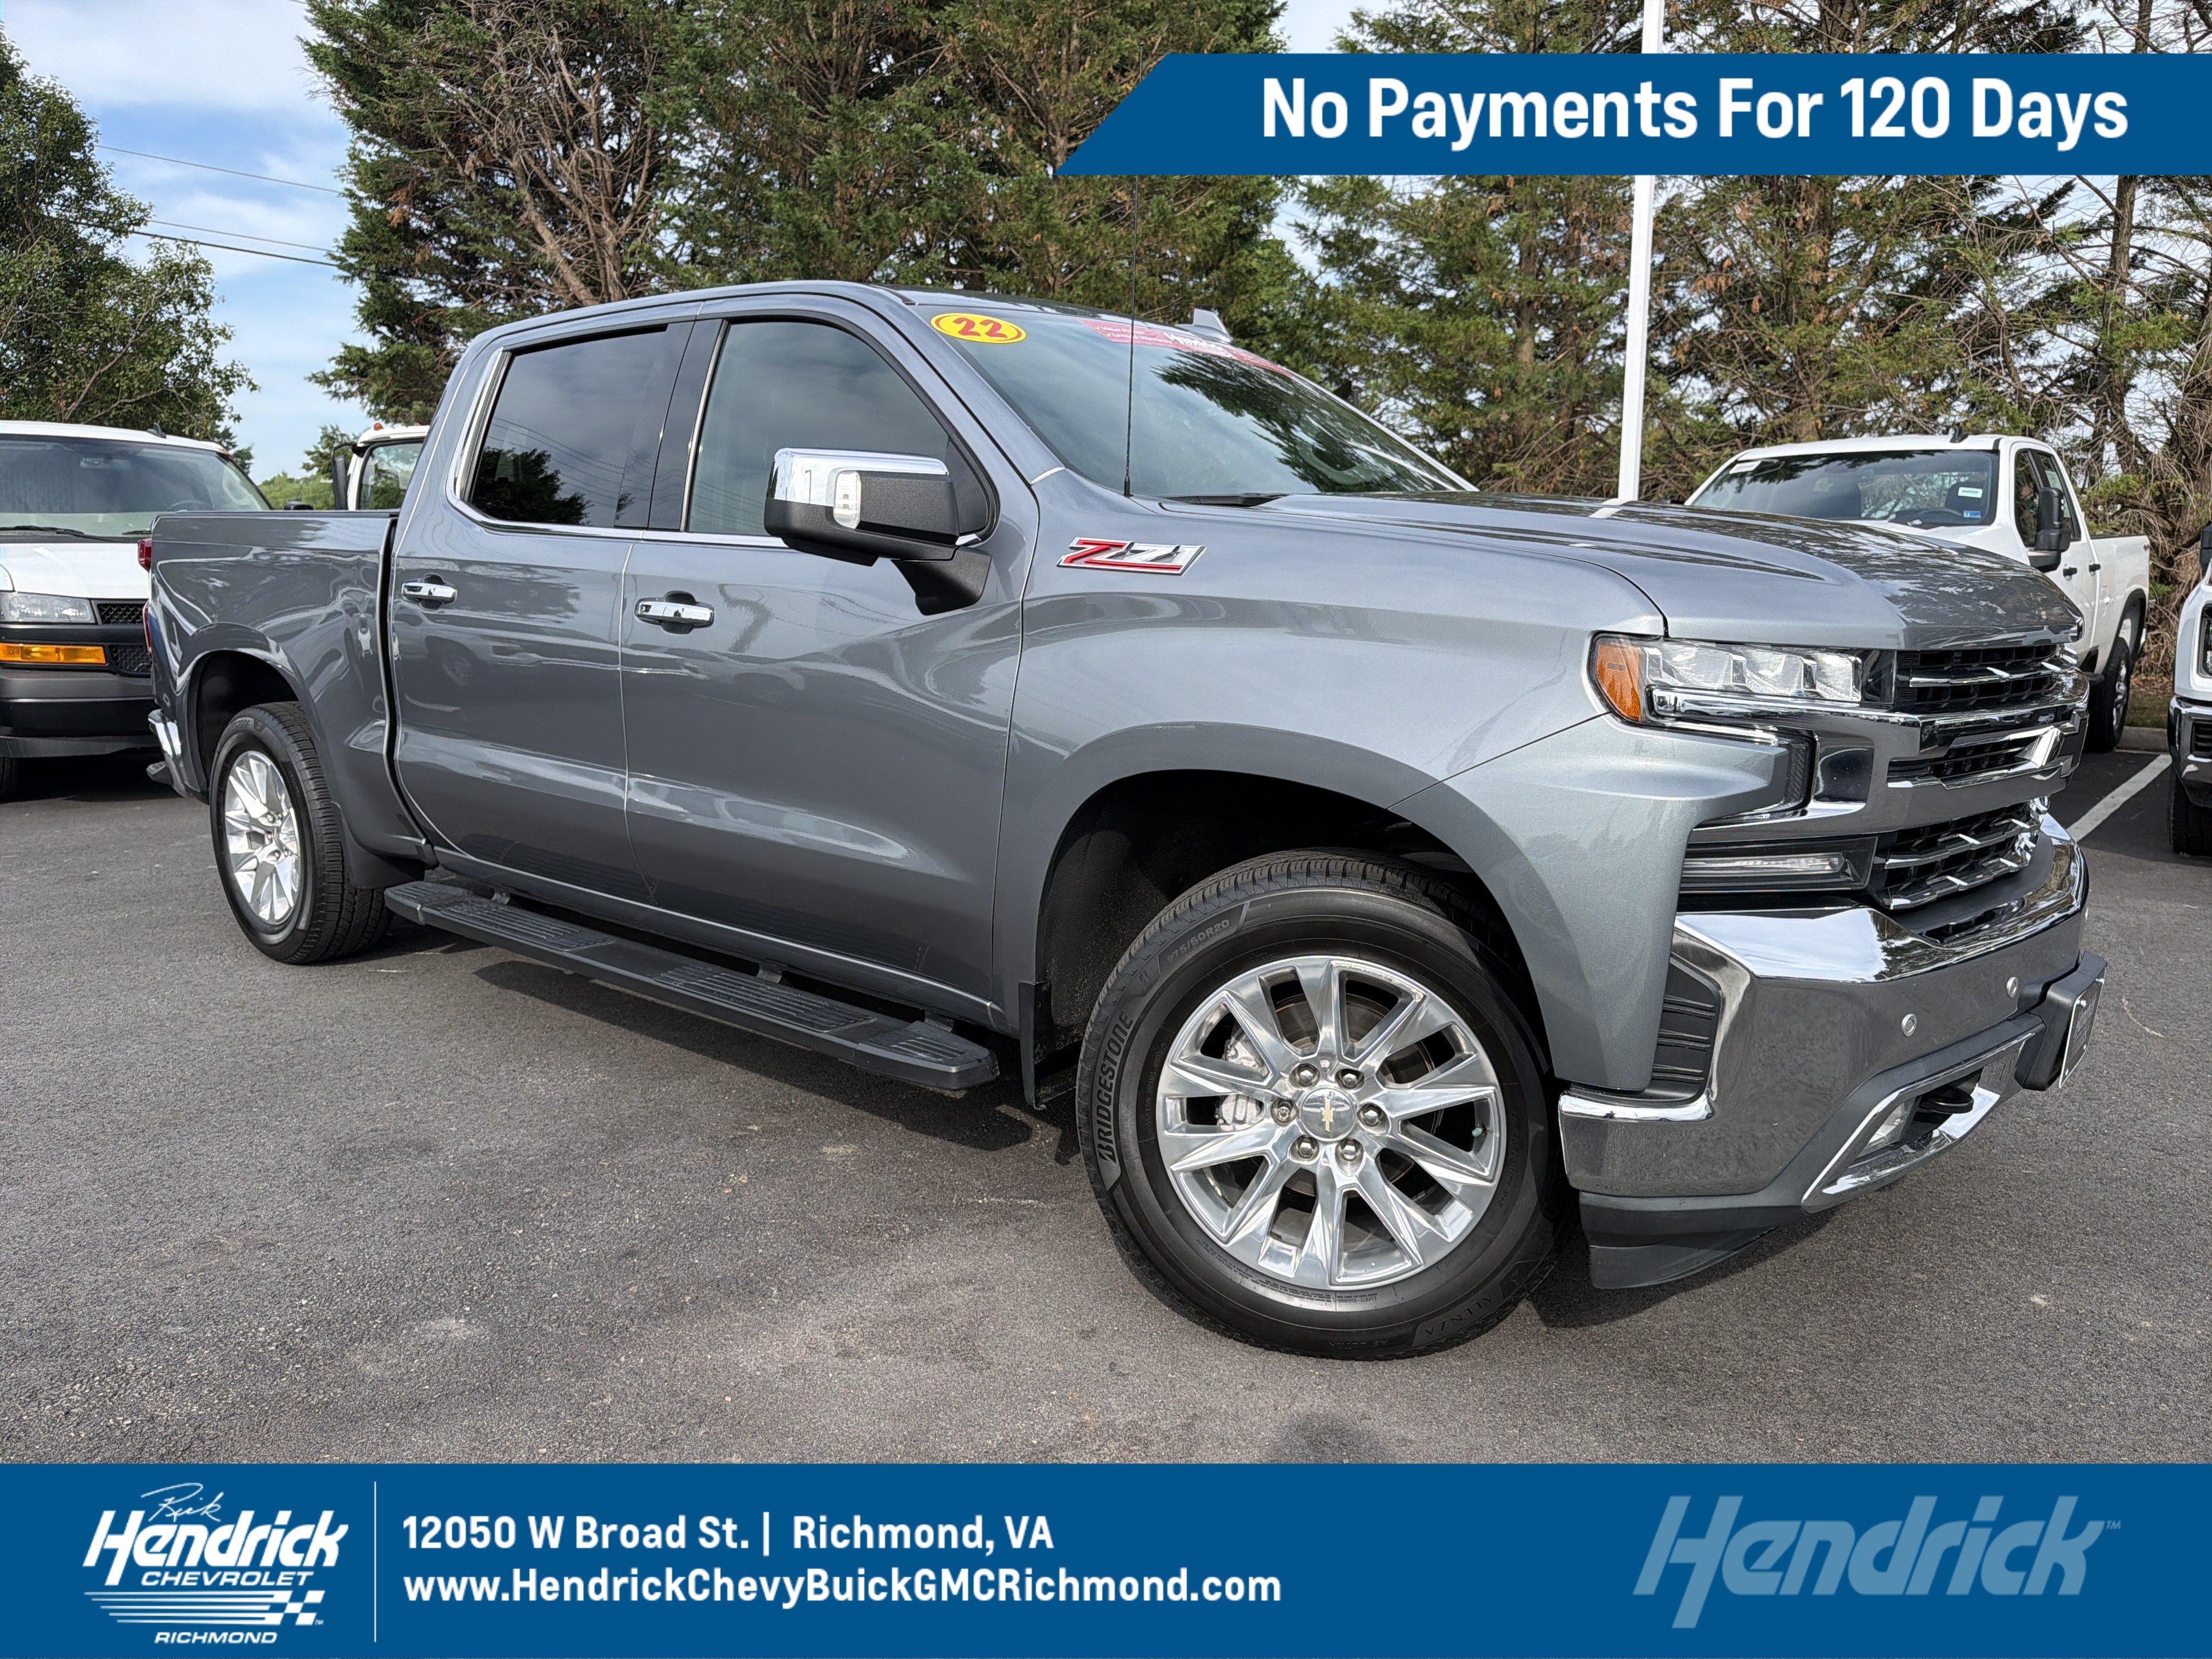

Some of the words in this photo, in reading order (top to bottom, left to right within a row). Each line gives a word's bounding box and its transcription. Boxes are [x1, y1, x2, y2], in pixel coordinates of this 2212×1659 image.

[952, 317, 1008, 338] 22
[1056, 537, 1207, 576] Z71
[1097, 1010, 1133, 1164] BRIDGESTONE
[1424, 1294, 1492, 1335] ALENZA
